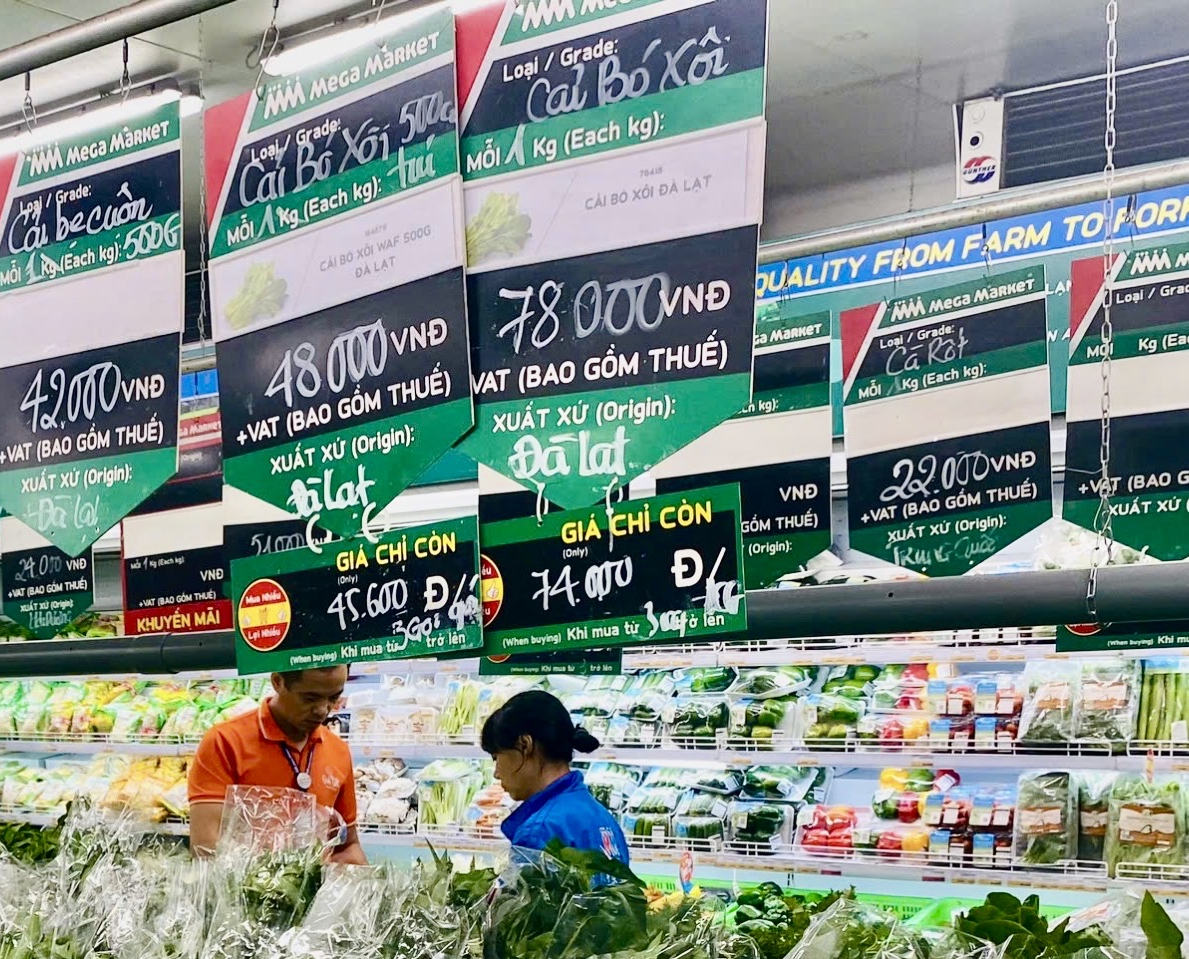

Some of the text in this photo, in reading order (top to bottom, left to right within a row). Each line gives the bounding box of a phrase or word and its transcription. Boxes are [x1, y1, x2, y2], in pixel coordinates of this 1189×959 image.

[503, 39, 619, 83] Loại Grade:
[279, 207, 299, 228] Kg
[304, 190, 348, 221] (Each
[353, 176, 382, 200] kg):
[403, 225, 431, 243] 500G
[756, 256, 867, 297] QUALITY
[873, 238, 955, 273] FROM
[962, 226, 1051, 259] FARM
[1063, 212, 1104, 241] TO
[659, 281, 731, 317] VNĐ
[1116, 290, 1143, 304] Loại
[390, 318, 448, 356] VNĐ
[880, 325, 955, 350] Loại Grade:
[121, 375, 165, 402] VNĐ
[859, 363, 987, 399] MỖI Kg (Each kg):
[237, 417, 280, 445] +VAT
[286, 403, 332, 437] (BAO
[338, 384, 381, 419] GỒM
[387, 362, 451, 406] THUẾ)
[493, 395, 676, 433] XUẤT XỨ (Origin):
[37, 438, 71, 462] (BAO
[76, 423, 111, 450] GỒM
[116, 412, 164, 445] THUẾ)
[270, 426, 415, 475] XUẤT XỨ (Origin):
[989, 451, 1036, 473] VNĐ
[21, 465, 133, 493] XUẤT XỨ (Origin):
[779, 484, 818, 502] VNĐ
[861, 477, 1037, 524] +VAT (BAO GỒM THUẾ)
[1109, 496, 1182, 516] XUẤT XỨ
[561, 499, 712, 544] GIÁ CHỈ CÒN
[887, 514, 1007, 542] XUẤT XỨ (Origin):
[336, 530, 455, 572] GIÁ CHỈ CÒN
[563, 547, 589, 559] (Only)
[749, 540, 792, 556] (Origin):
[66, 558, 87, 571] VNĐ
[200, 568, 223, 581] VNĐ
[671, 549, 703, 588] Đ
[337, 574, 358, 586] (Only)
[137, 607, 220, 632] KHUYẾN MÃI
[313, 652, 337, 665] buying)
[341, 643, 358, 659] Khi
[361, 644, 383, 657] mua
[426, 634, 444, 647] trở
[449, 632, 465, 644] lên
[502, 638, 530, 648] (When
[531, 633, 561, 646] buying)
[567, 628, 588, 641] Khi
[592, 626, 619, 638] mua
[624, 621, 640, 635] từ
[1158, 636, 1173, 644] Khi
